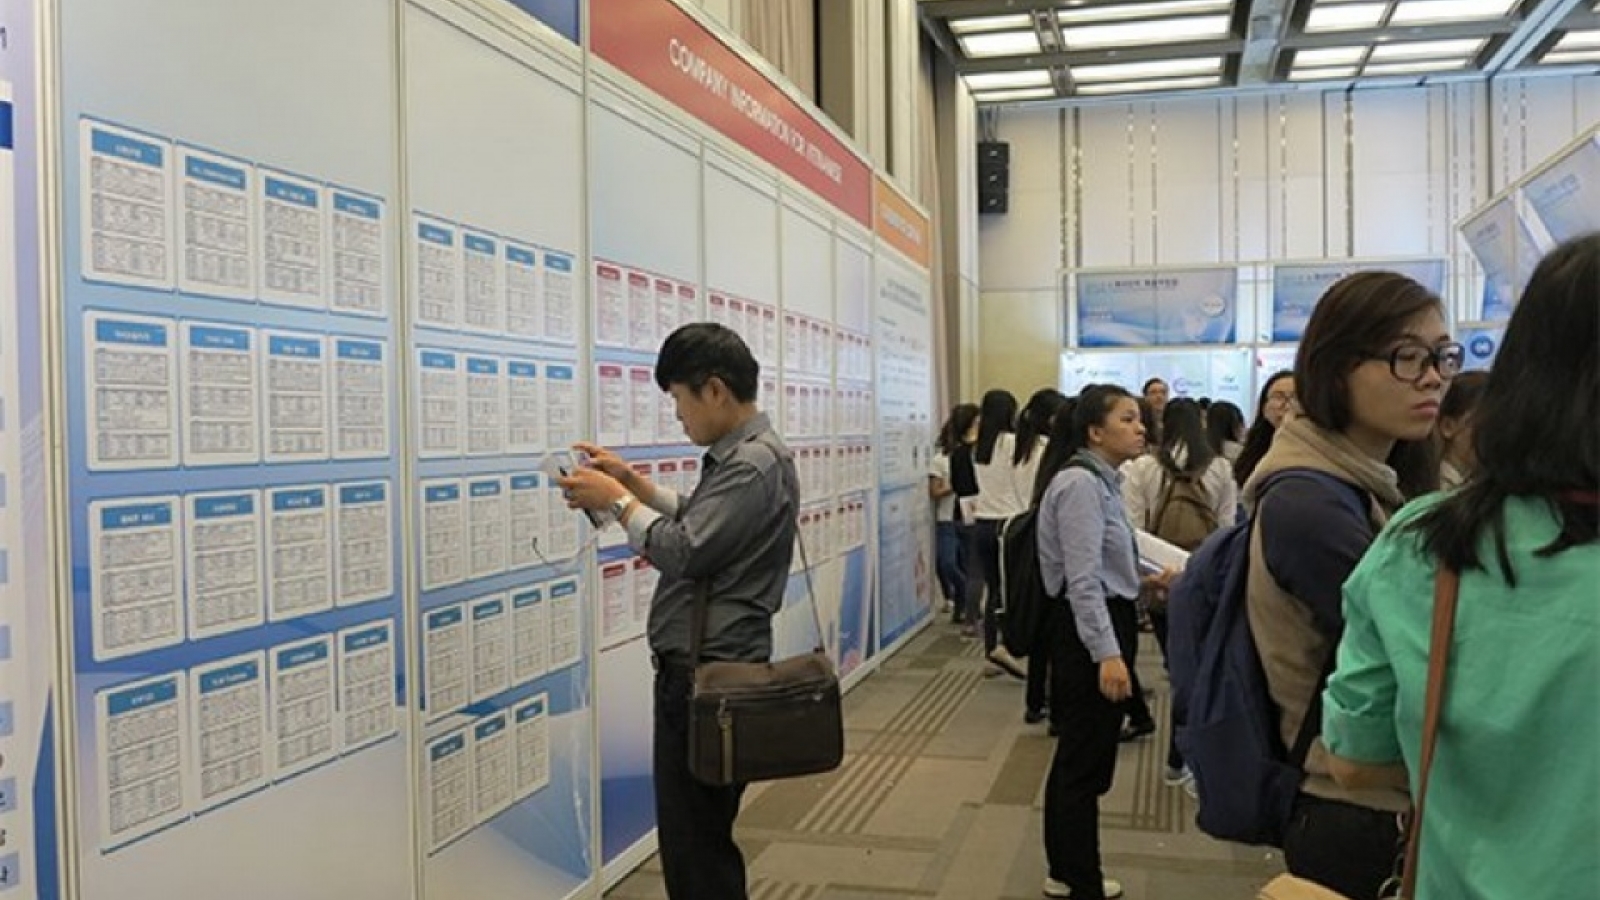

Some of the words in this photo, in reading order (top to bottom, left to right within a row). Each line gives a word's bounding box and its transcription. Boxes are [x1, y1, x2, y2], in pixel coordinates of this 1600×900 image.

[669, 38, 728, 99] COMPANY
[730, 82, 789, 145] INFORMATION
[790, 127, 806, 156] FOR
